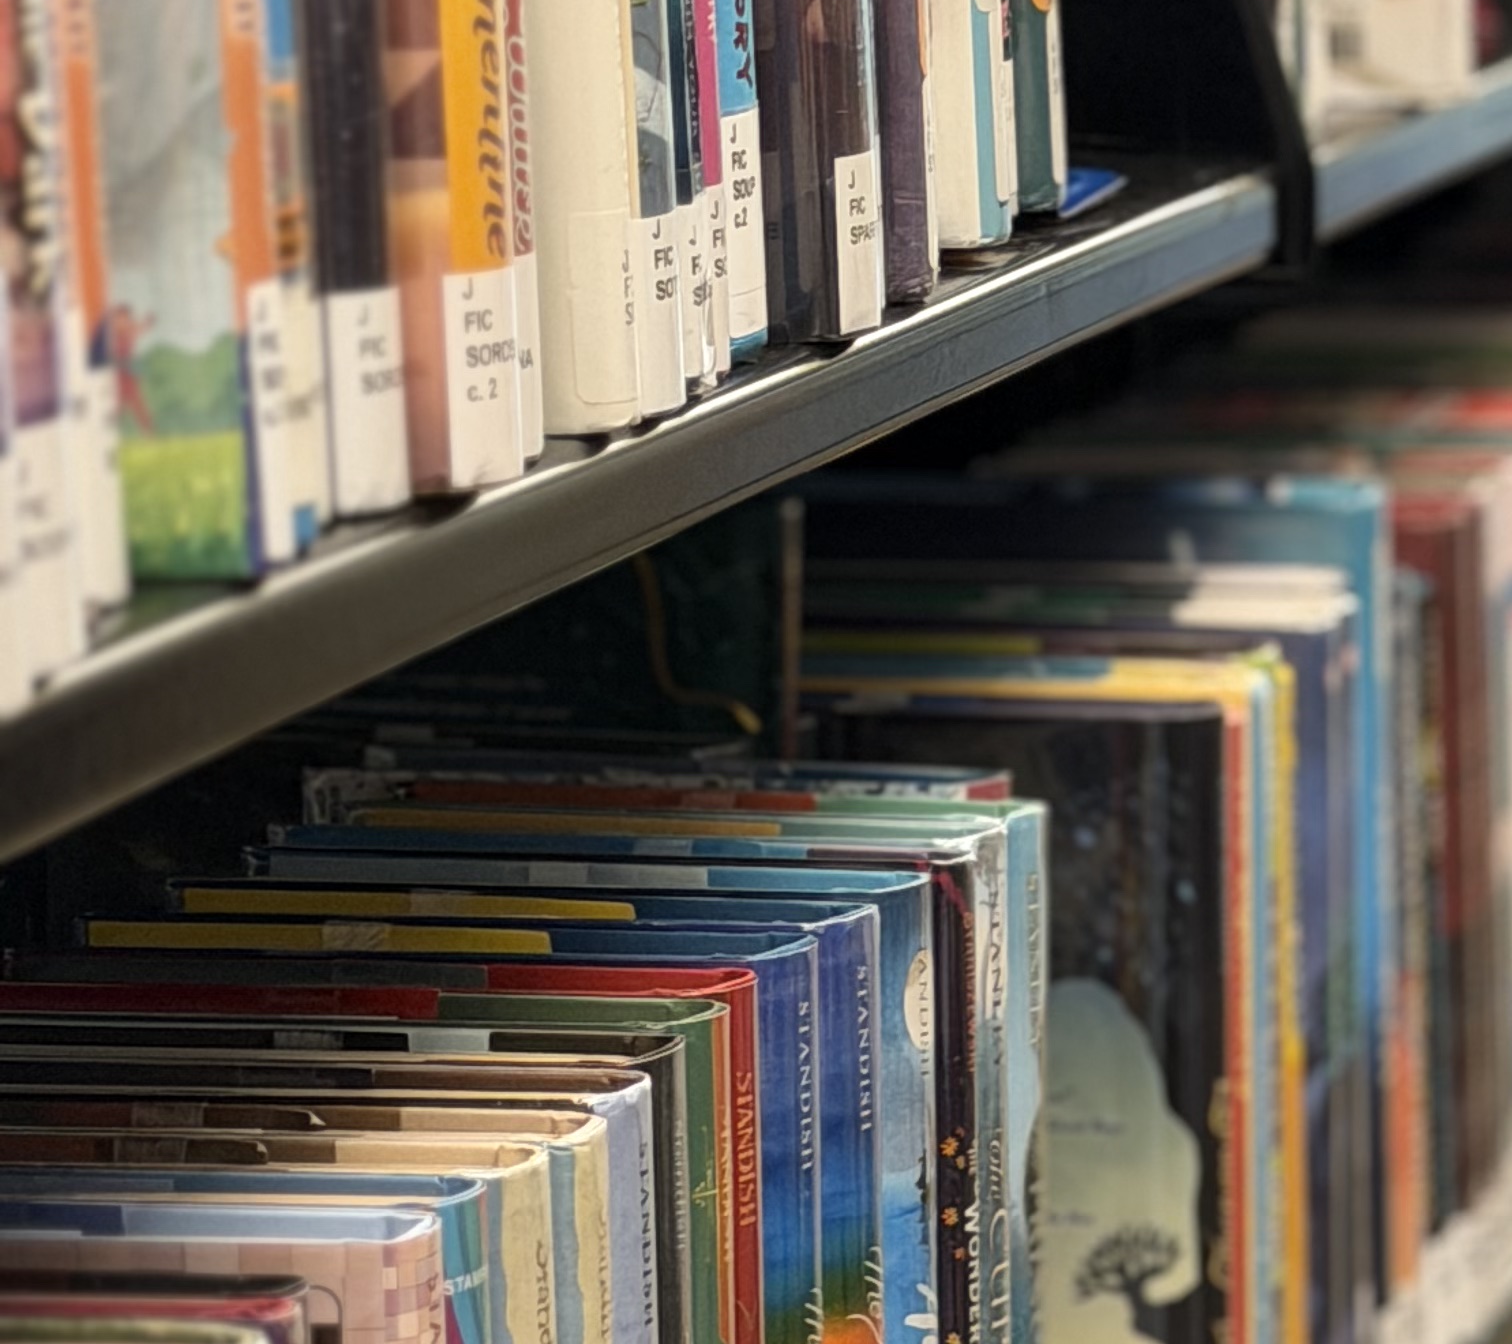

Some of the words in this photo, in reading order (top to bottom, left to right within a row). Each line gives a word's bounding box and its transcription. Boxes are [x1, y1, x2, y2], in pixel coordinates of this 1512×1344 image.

[730, 123, 737, 144] J
[848, 169, 856, 189] J
[652, 219, 661, 240] J
[653, 246, 673, 270] FIC
[462, 276, 474, 301] J
[463, 308, 494, 335] FIC
[855, 964, 873, 1133] STANDISH
[798, 999, 814, 1171] STANDISH
[736, 1070, 757, 1229] STANDISH
